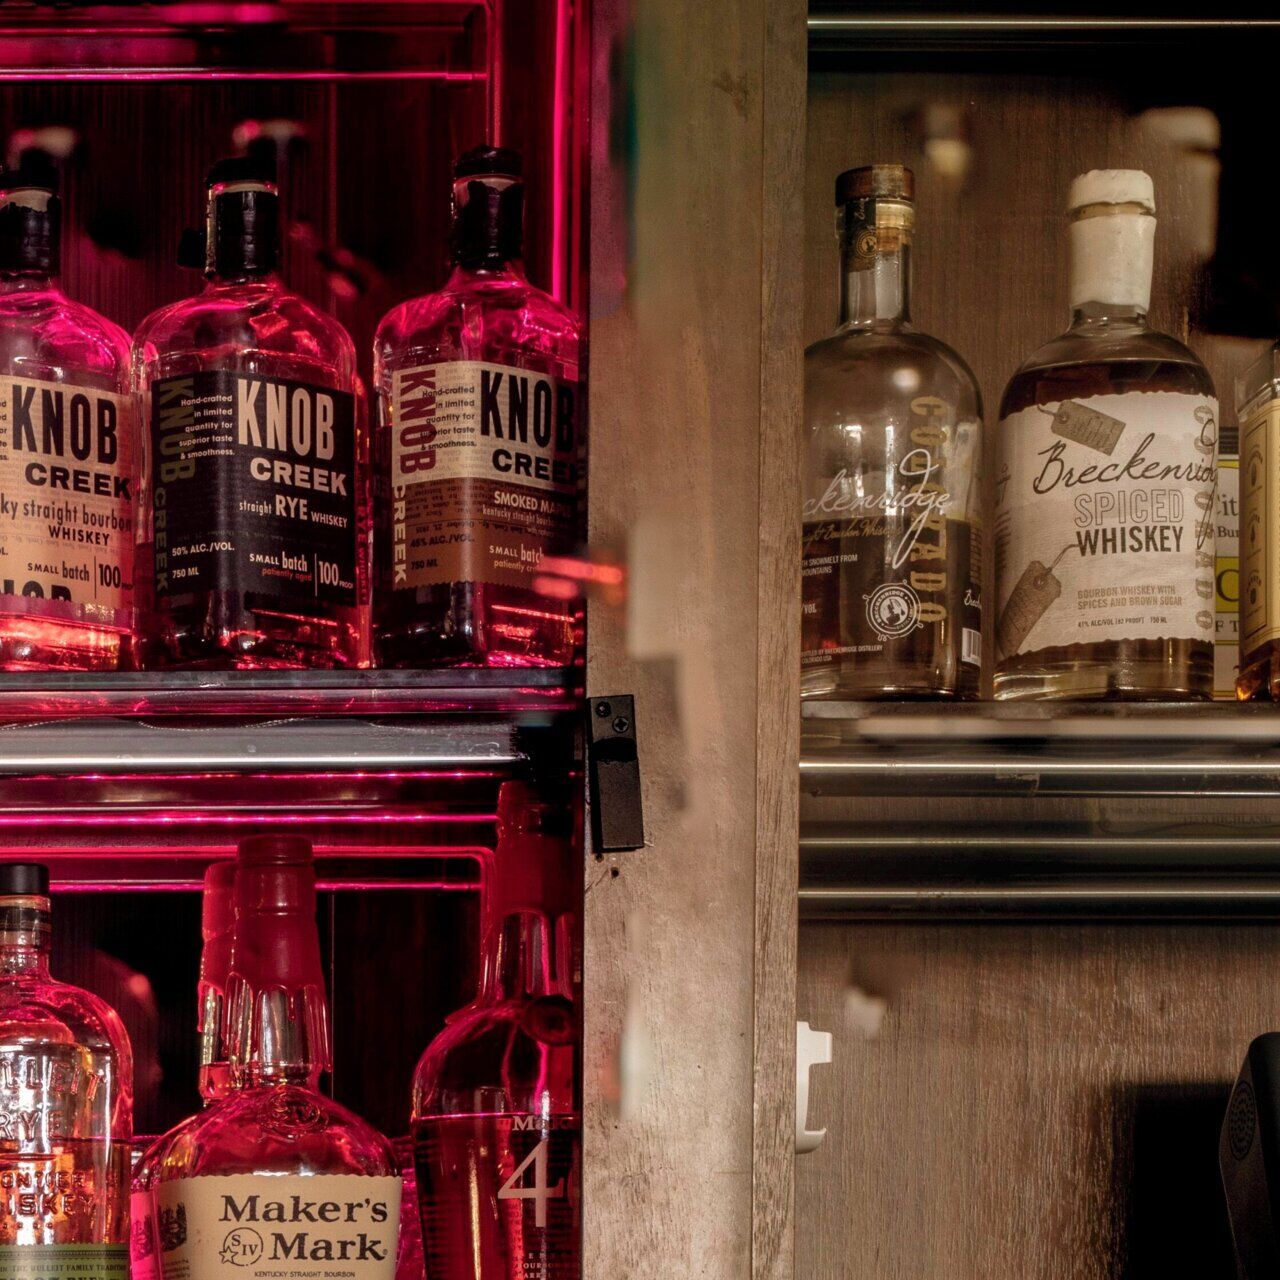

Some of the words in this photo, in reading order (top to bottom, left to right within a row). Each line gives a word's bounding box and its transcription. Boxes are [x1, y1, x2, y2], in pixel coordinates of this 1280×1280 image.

[12, 384, 117, 465] KNOB
[238, 378, 334, 460] KNOB
[480, 369, 575, 455] KNOB
[25, 462, 132, 500] CREEK
[250, 457, 347, 496] CREEK
[23, 502, 77, 526] straight
[82, 504, 132, 531] bourbon
[239, 500, 272, 516] straight
[276, 494, 308, 521] RYE
[311, 512, 348, 528] WHISKEY
[494, 491, 538, 510] SMOKED
[1074, 488, 1184, 528] SPICED
[48, 525, 110, 547] WHISKEY
[1076, 525, 1184, 557] WHISKEY
[27, 562, 59, 574] SMALL
[62, 561, 89, 582] batch
[99, 563, 121, 589] 100
[1078, 586, 1117, 599] BOURBON
[1119, 586, 1156, 598] WHISKEY
[1157, 585, 1175, 595] WITH
[498, 1140, 564, 1228] 4
[218, 1194, 388, 1223] Maker's
[268, 1232, 384, 1261] Mark
